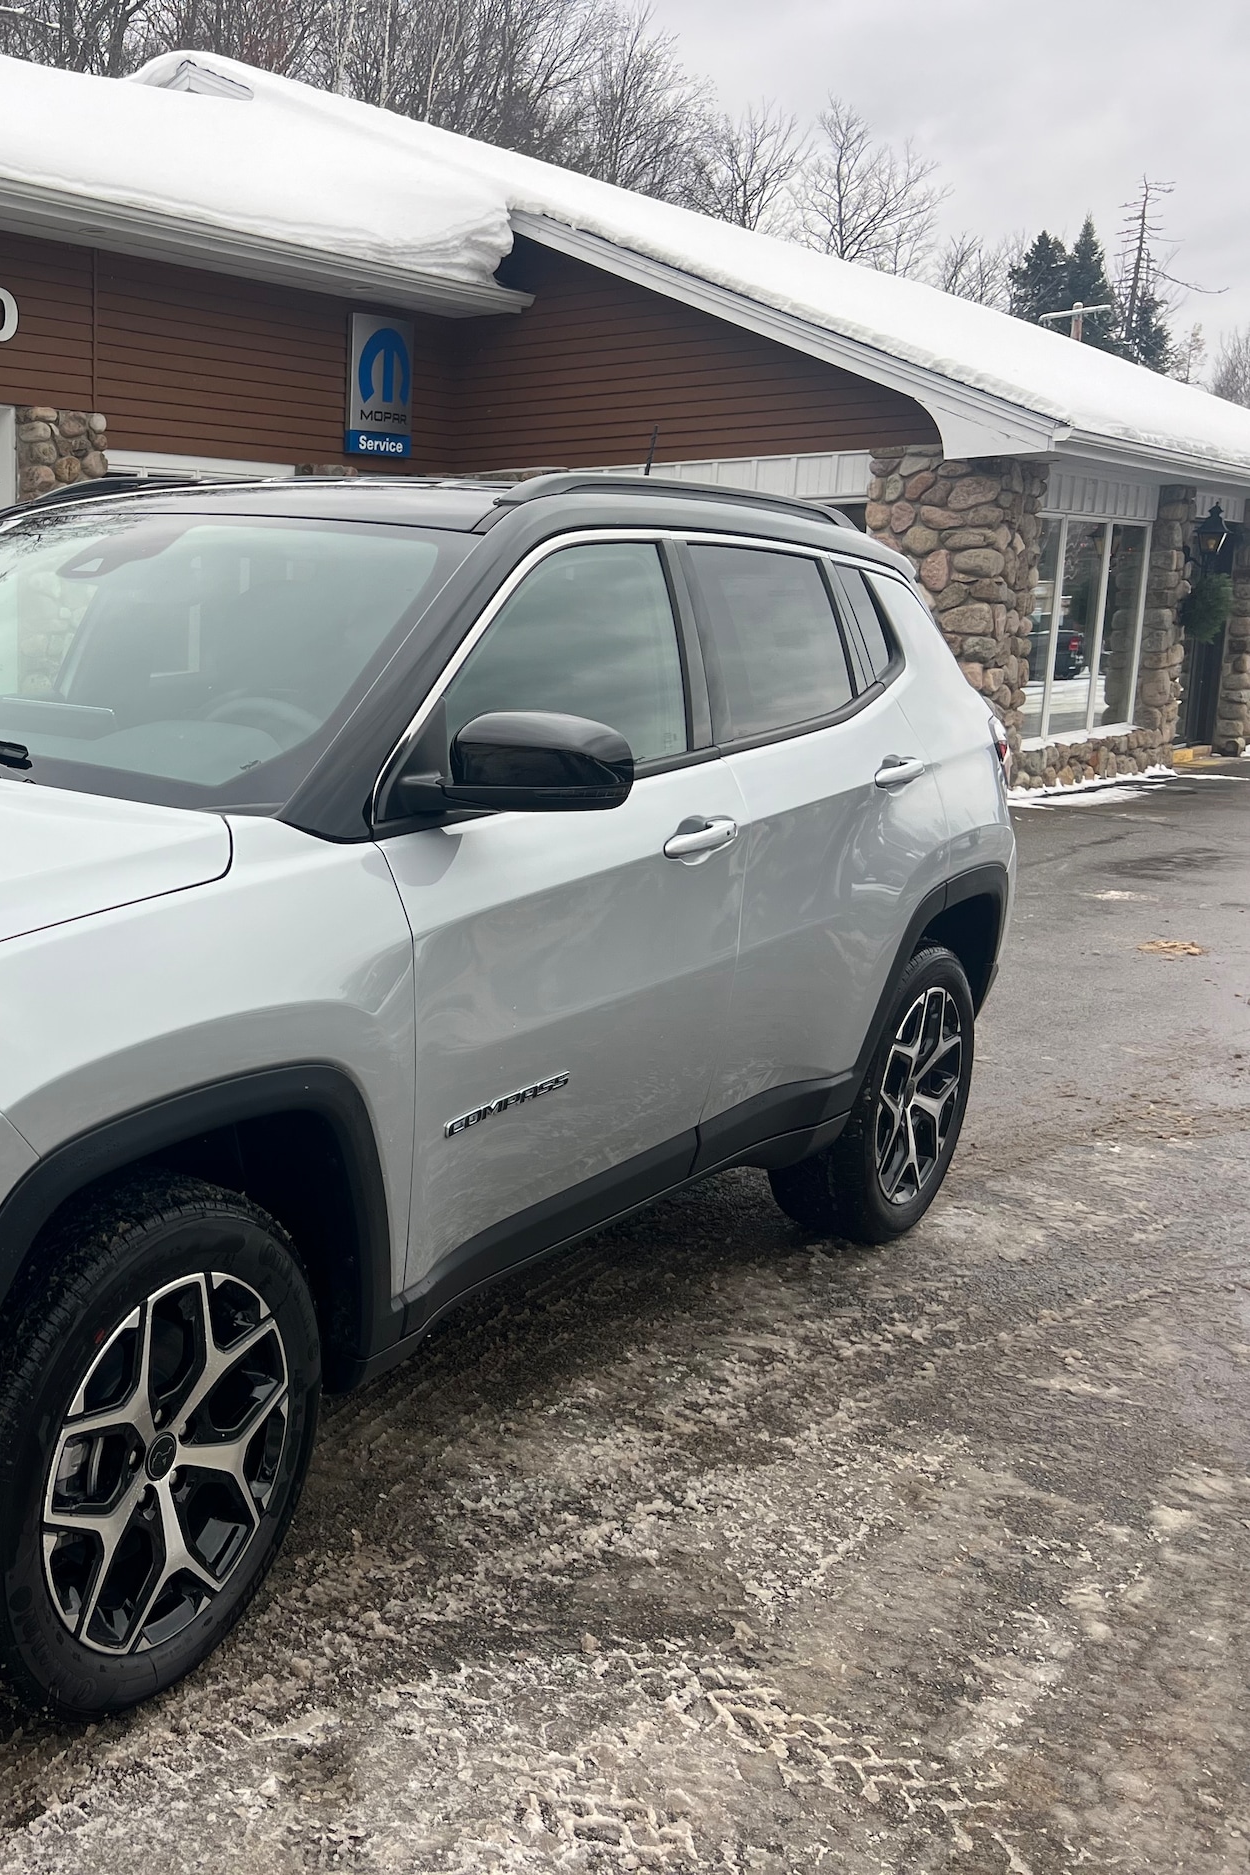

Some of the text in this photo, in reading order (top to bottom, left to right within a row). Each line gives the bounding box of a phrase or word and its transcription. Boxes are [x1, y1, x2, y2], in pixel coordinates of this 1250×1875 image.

[360, 409, 407, 424] MOPAR
[358, 434, 403, 453] Service
[443, 1070, 571, 1139] COMPASS
